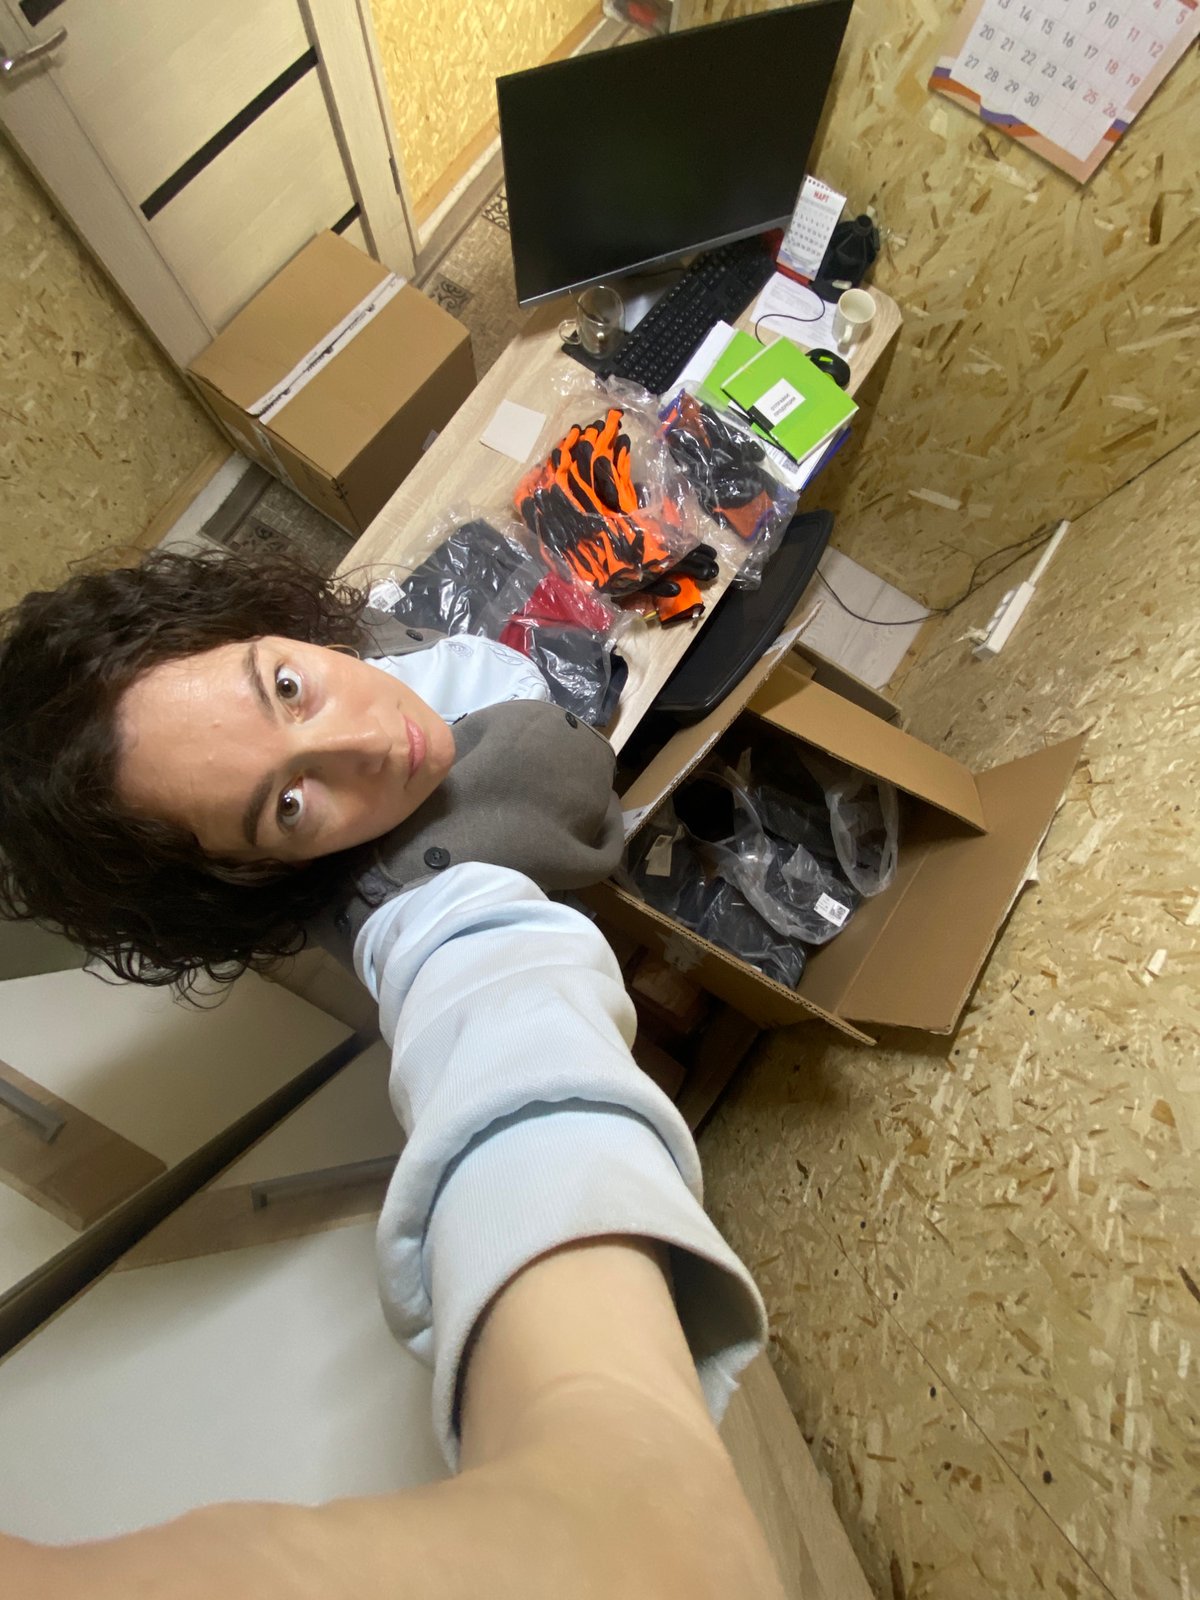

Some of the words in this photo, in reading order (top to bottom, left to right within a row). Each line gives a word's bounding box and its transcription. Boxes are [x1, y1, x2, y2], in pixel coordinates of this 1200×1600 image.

[1087, 1, 1097, 14] 9
[1105, 11, 1119, 29] 10
[1127, 27, 1140, 42] 11
[1148, 41, 1164, 58] 12
[1176, 9, 1189, 24] 5
[979, 24, 995, 40] 20
[1000, 37, 1015, 52] 21
[1020, 49, 1037, 66] 22
[1041, 62, 1057, 78] 23
[1062, 75, 1078, 91] 24
[1082, 88, 1098, 105] 25
[1102, 102, 1118, 118] 26
[1019, 5, 1033, 22] 14
[1041, 18, 1055, 35] 15
[1062, 31, 1076, 48] 16
[1084, 44, 1099, 59] 17
[1105, 59, 1119, 75] 18
[1126, 73, 1141, 88] 19
[964, 54, 980, 70] 27
[984, 67, 999, 83] 28
[1004, 79, 1020, 93] 29
[1024, 91, 1040, 107] 30
[813, 190, 830, 203] МАРТ
